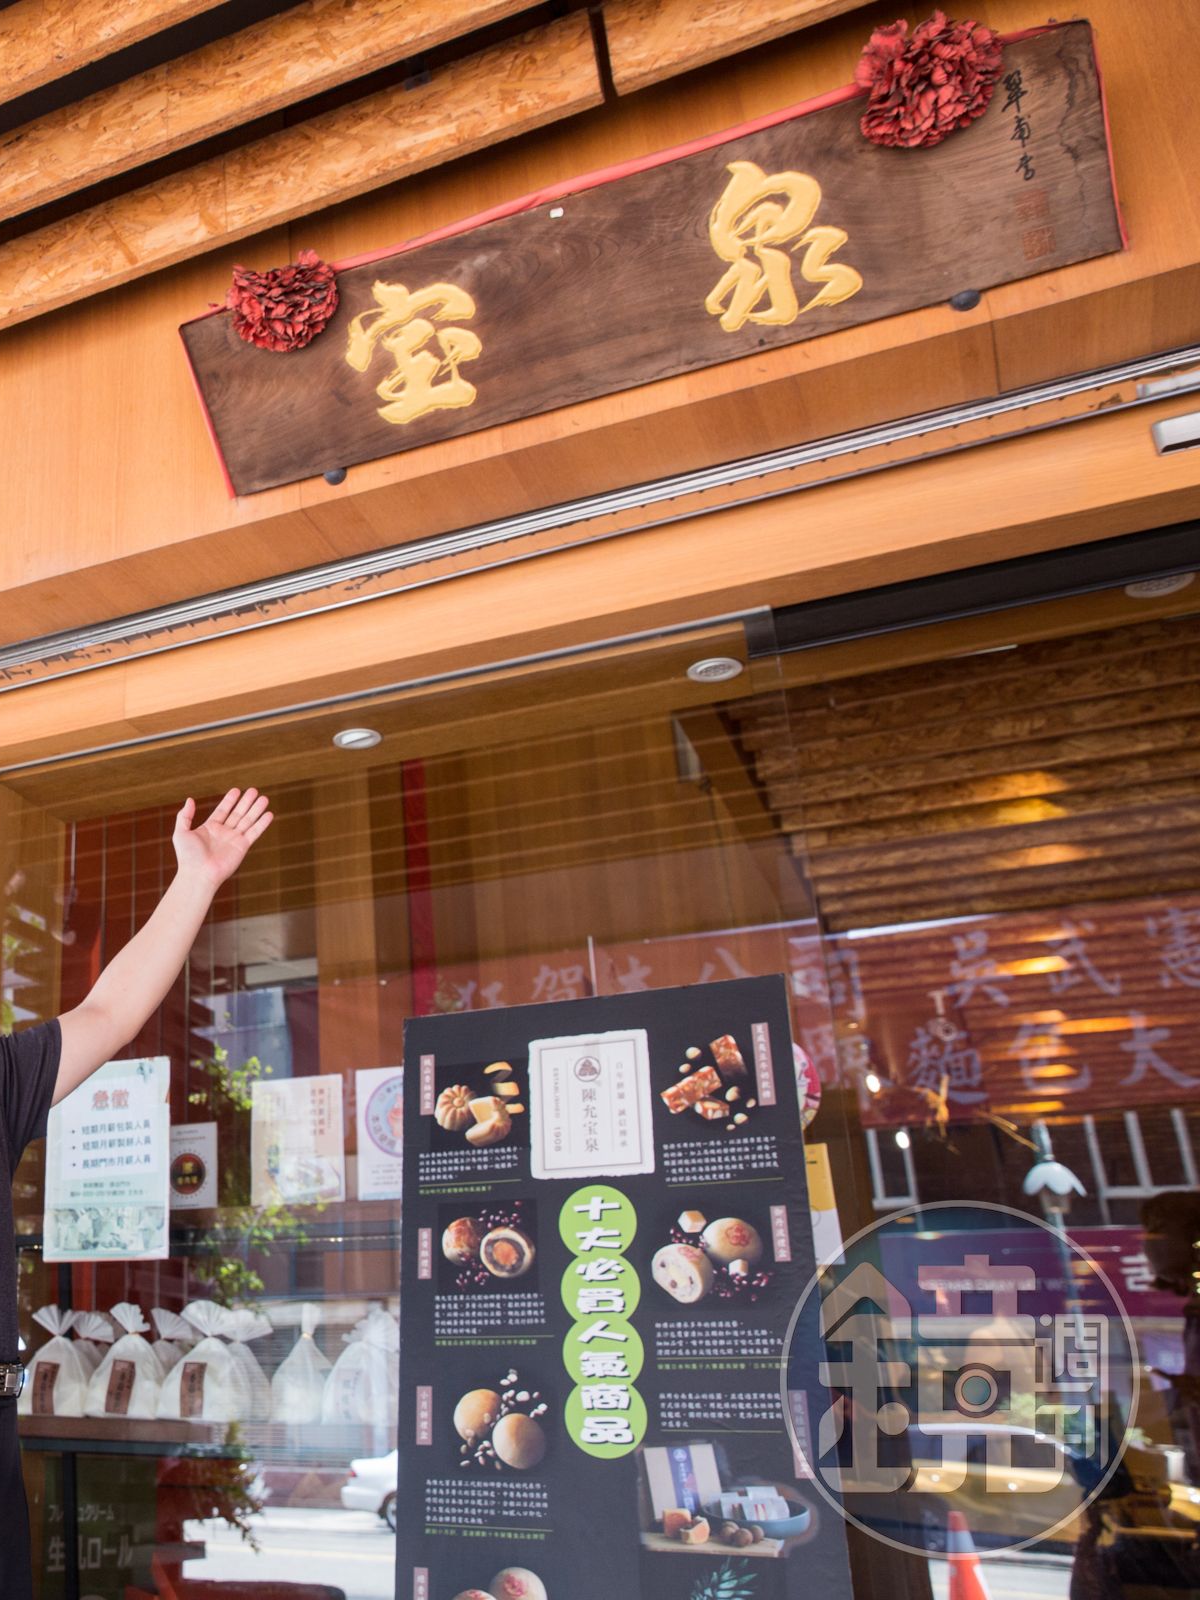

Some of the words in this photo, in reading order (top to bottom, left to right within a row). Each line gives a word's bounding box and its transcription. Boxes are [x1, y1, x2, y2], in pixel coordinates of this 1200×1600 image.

[572, 1195, 635, 1446] 十大必買人氣商品
